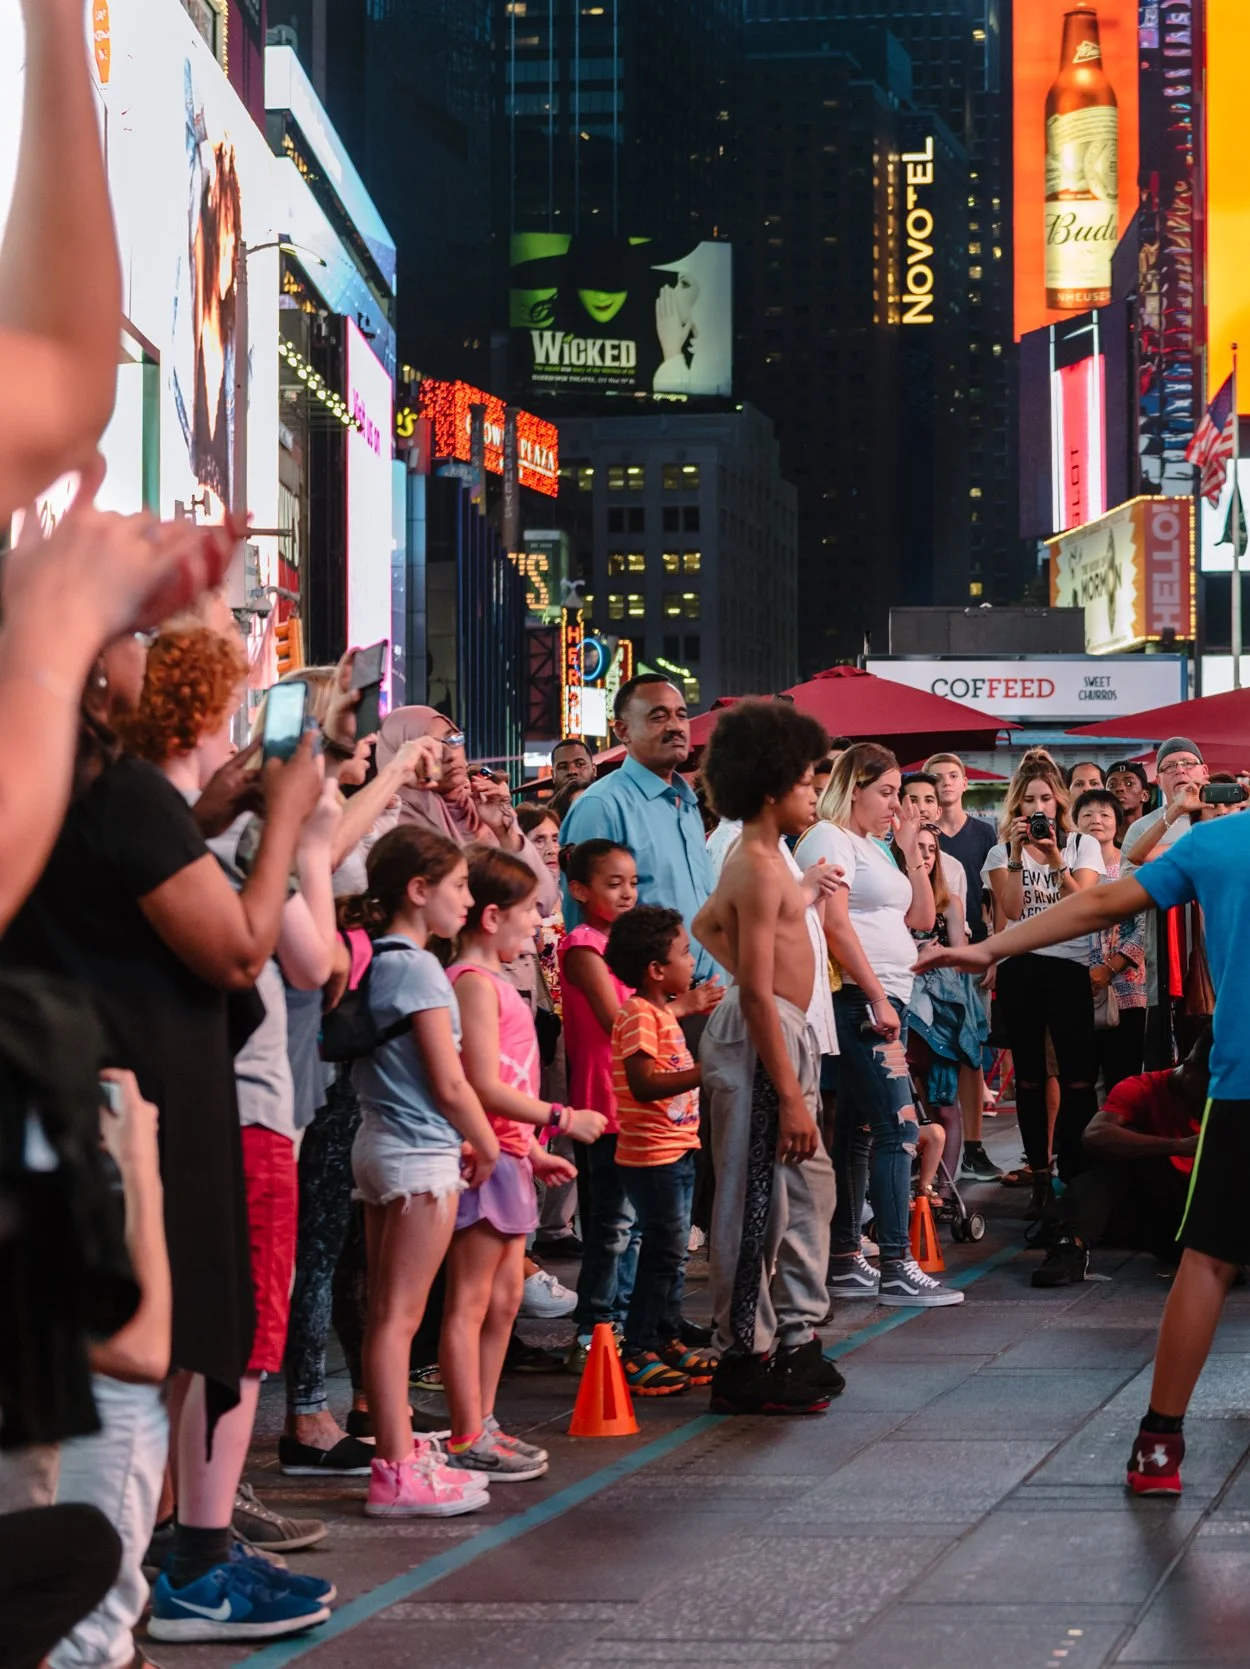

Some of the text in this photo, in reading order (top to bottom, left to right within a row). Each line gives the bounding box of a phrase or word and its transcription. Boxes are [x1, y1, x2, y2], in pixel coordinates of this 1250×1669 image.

[902, 136, 934, 324] NOVOTEL
[520, 437, 555, 471] PLAZA
[1152, 503, 1181, 631] HELLO!
[931, 678, 1055, 699] COFFEED
[1079, 689, 1117, 702] CHURROS
[1084, 676, 1111, 688] SWEET
